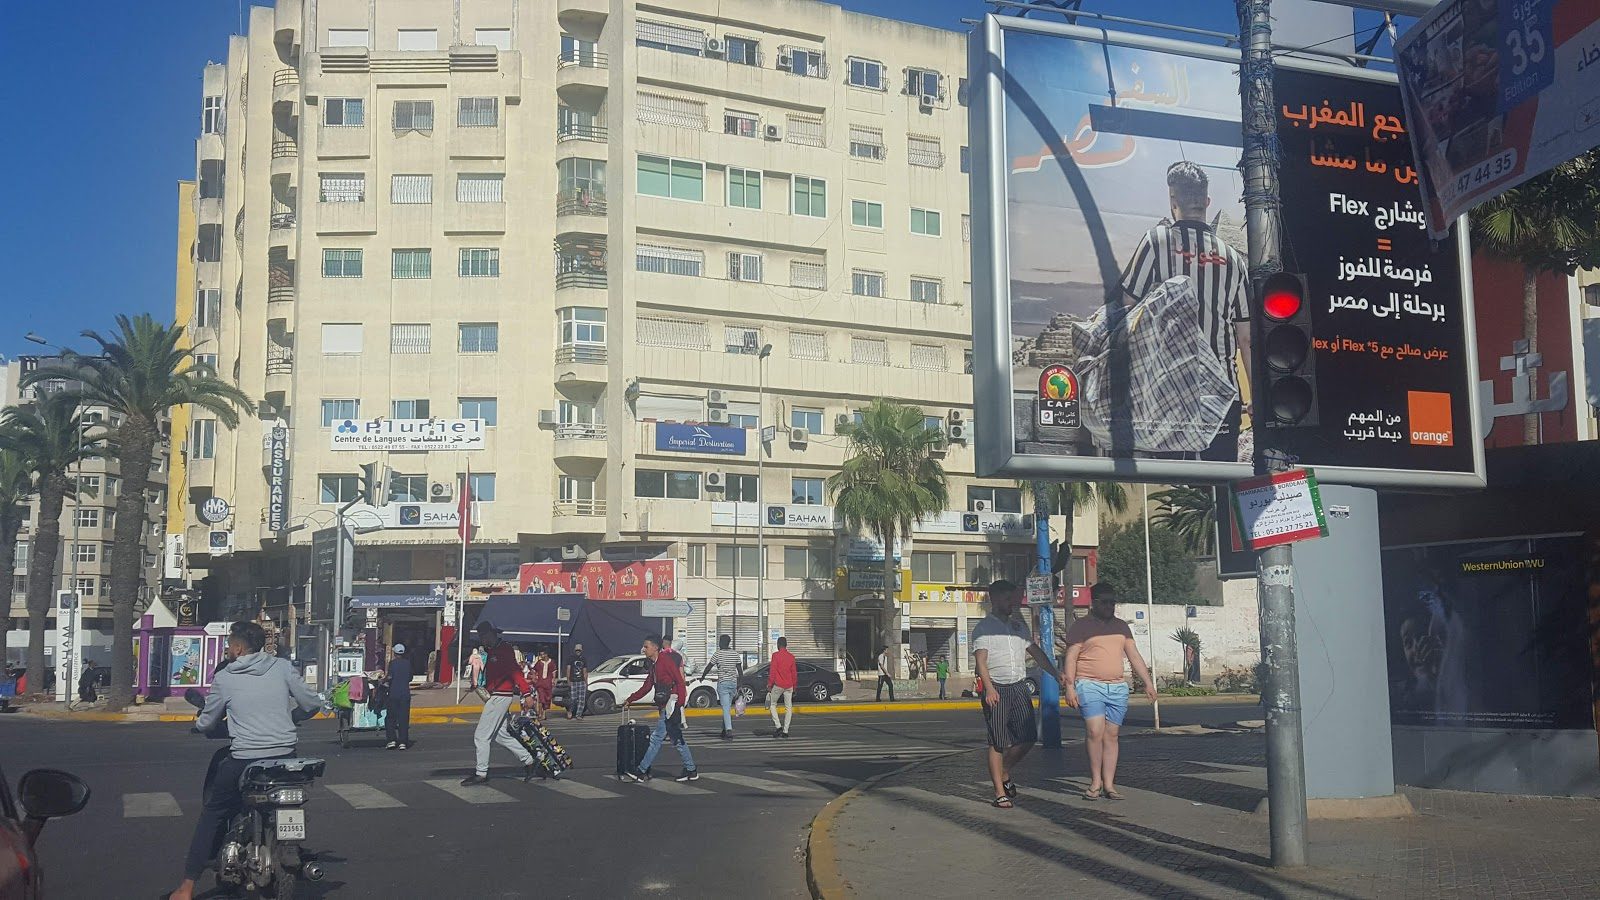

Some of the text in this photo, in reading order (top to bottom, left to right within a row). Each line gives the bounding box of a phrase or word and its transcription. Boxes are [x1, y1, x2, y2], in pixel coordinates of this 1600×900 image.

[1506, 14, 1545, 75] 35
[1282, 99, 1364, 128] المغرب
[1475, 163, 1491, 184] 44
[1495, 153, 1511, 174] 35
[1329, 193, 1369, 216] Flex
[1338, 256, 1433, 287] فرصة للفوز
[1328, 292, 1446, 323] برحلة إلى مصر
[1342, 339, 1365, 352] Flex
[1396, 344, 1421, 360] صالح
[1380, 346, 1394, 360] مع
[1423, 348, 1448, 360] عرض
[1047, 400, 1072, 408] CAF
[1348, 409, 1401, 426] من المهم
[366, 419, 479, 433] Pluriel
[334, 435, 407, 445] Centre de Langues
[410, 435, 447, 444] اللغات
[1343, 426, 1402, 442] ديما قريب
[1412, 430, 1449, 444] orange
[668, 435, 696, 447] Imperial
[699, 437, 736, 449] Destination
[271, 440, 285, 531] ASSURANCES
[1277, 480, 1309, 490] BORDEAUX
[206, 498, 226, 514] HMB
[1248, 491, 1303, 510] صيدلية بوردو
[424, 512, 460, 521] SAHA
[788, 513, 827, 524] SAHAM
[981, 521, 1015, 531] SAHAM
[1251, 529, 1261, 538] TEL
[1266, 527, 1274, 535] 05
[1276, 525, 1284, 533] 22
[1285, 524, 1293, 532] 27
[1295, 522, 1304, 530] 75
[1305, 520, 1314, 528] 21
[1462, 559, 1525, 571] WesternUnion
